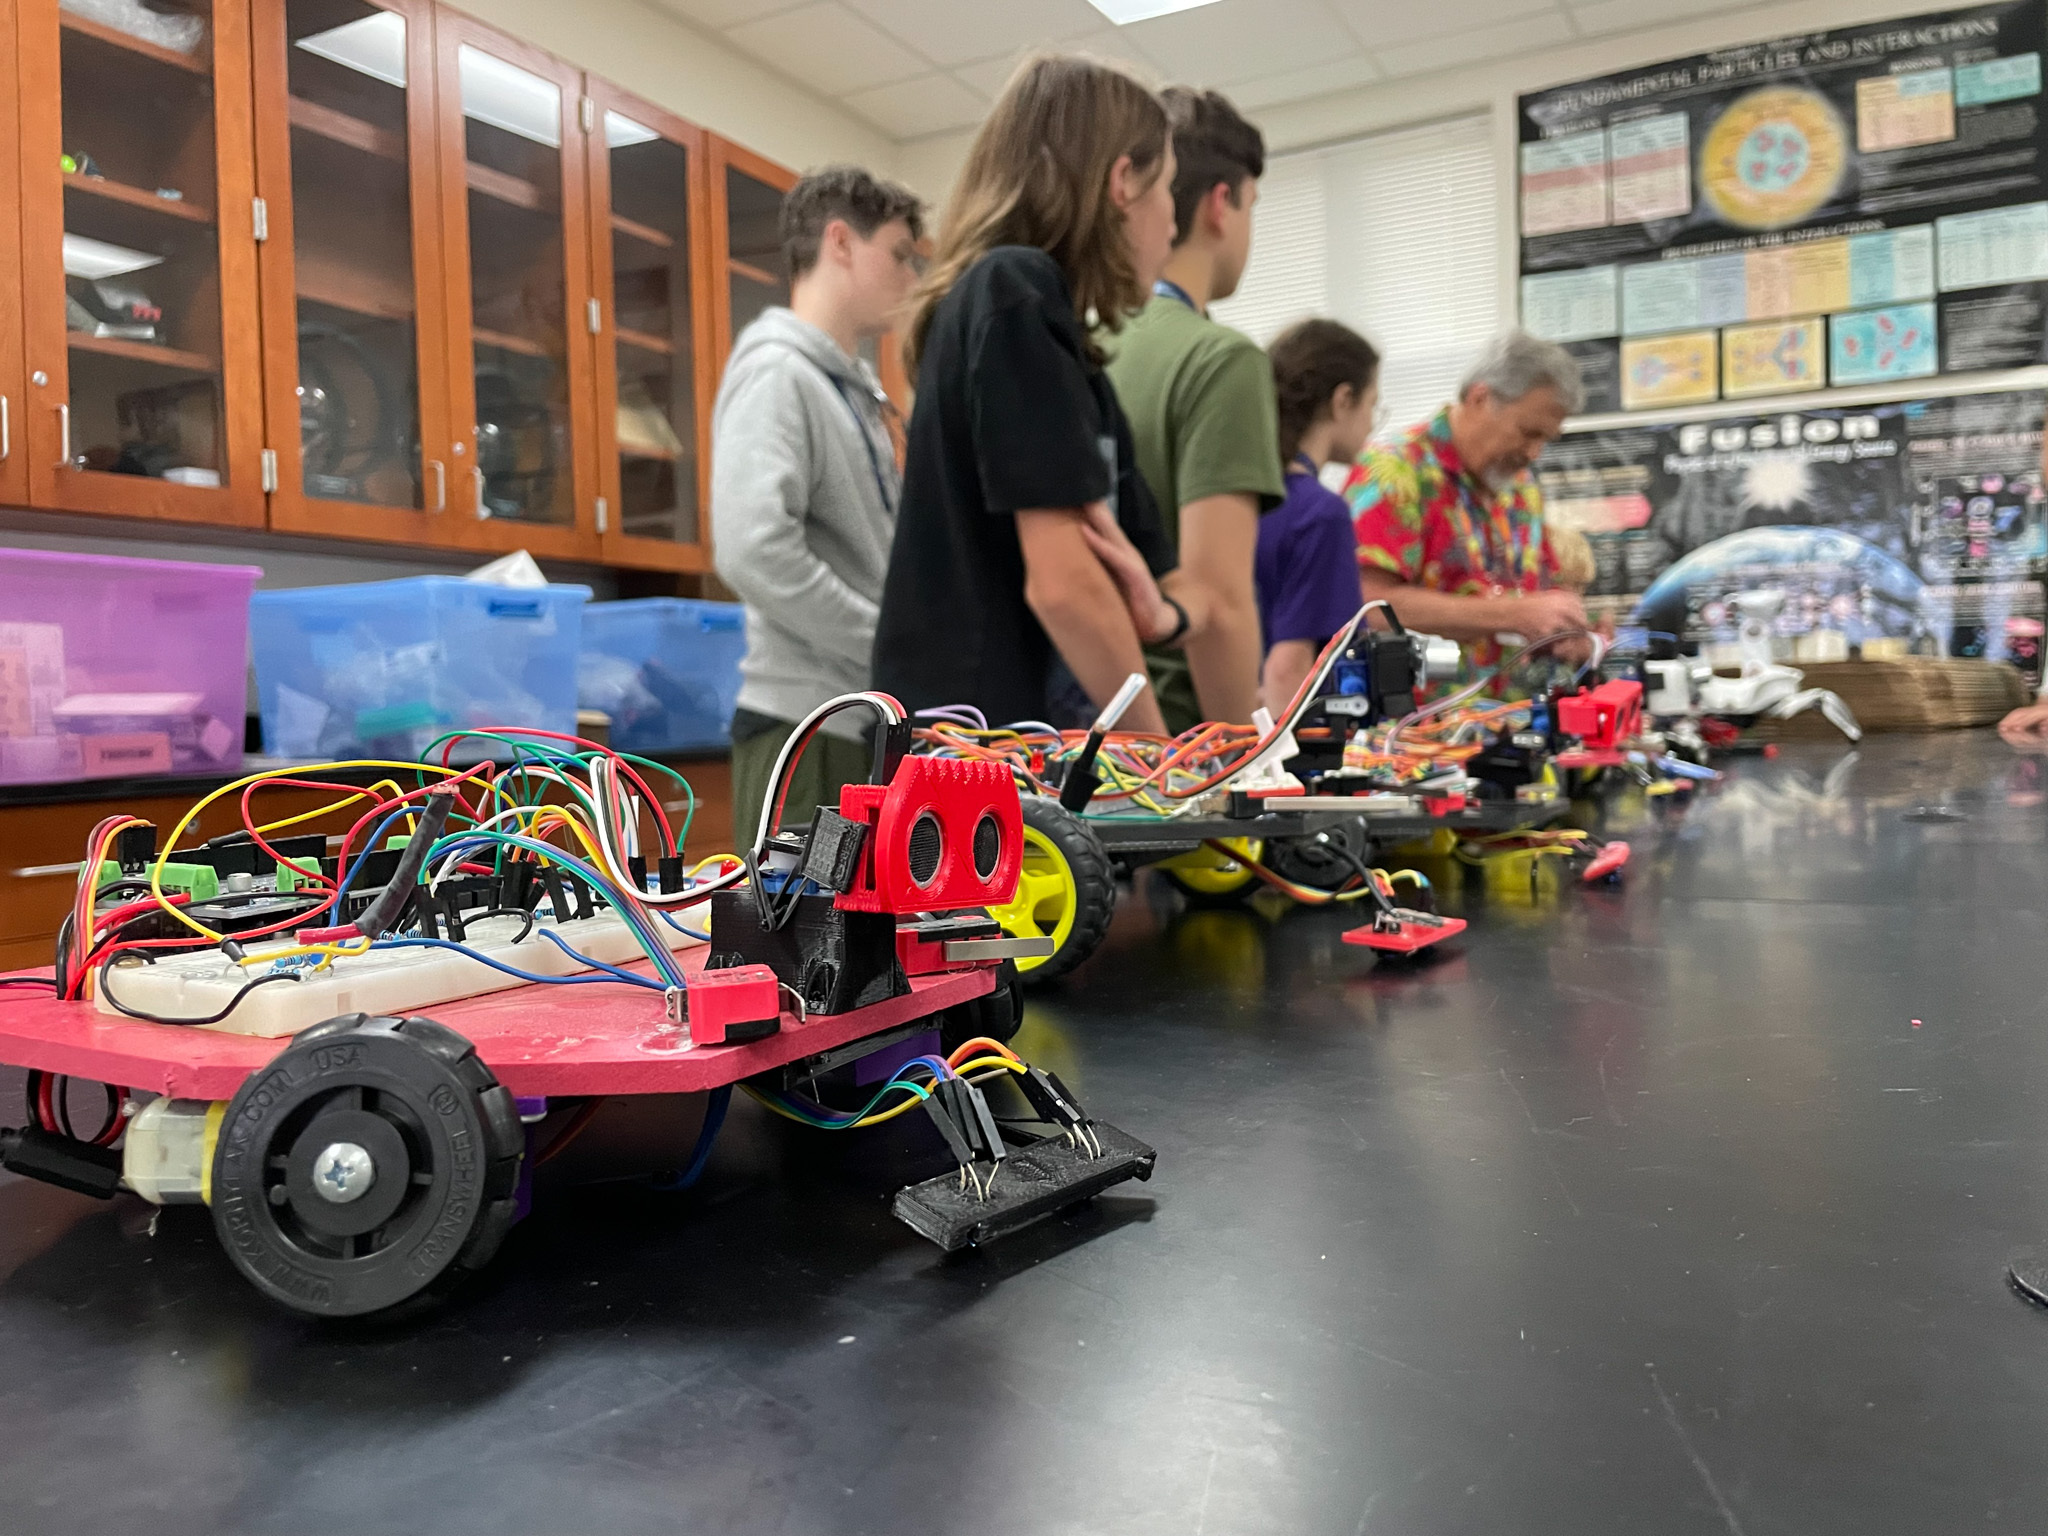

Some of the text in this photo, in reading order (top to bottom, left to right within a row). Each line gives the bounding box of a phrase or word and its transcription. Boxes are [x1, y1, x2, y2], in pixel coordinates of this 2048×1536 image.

[1679, 414, 1880, 455] Fusion
[315, 1048, 361, 1070] USA
[415, 1122, 476, 1267] TRANSWHEEL
